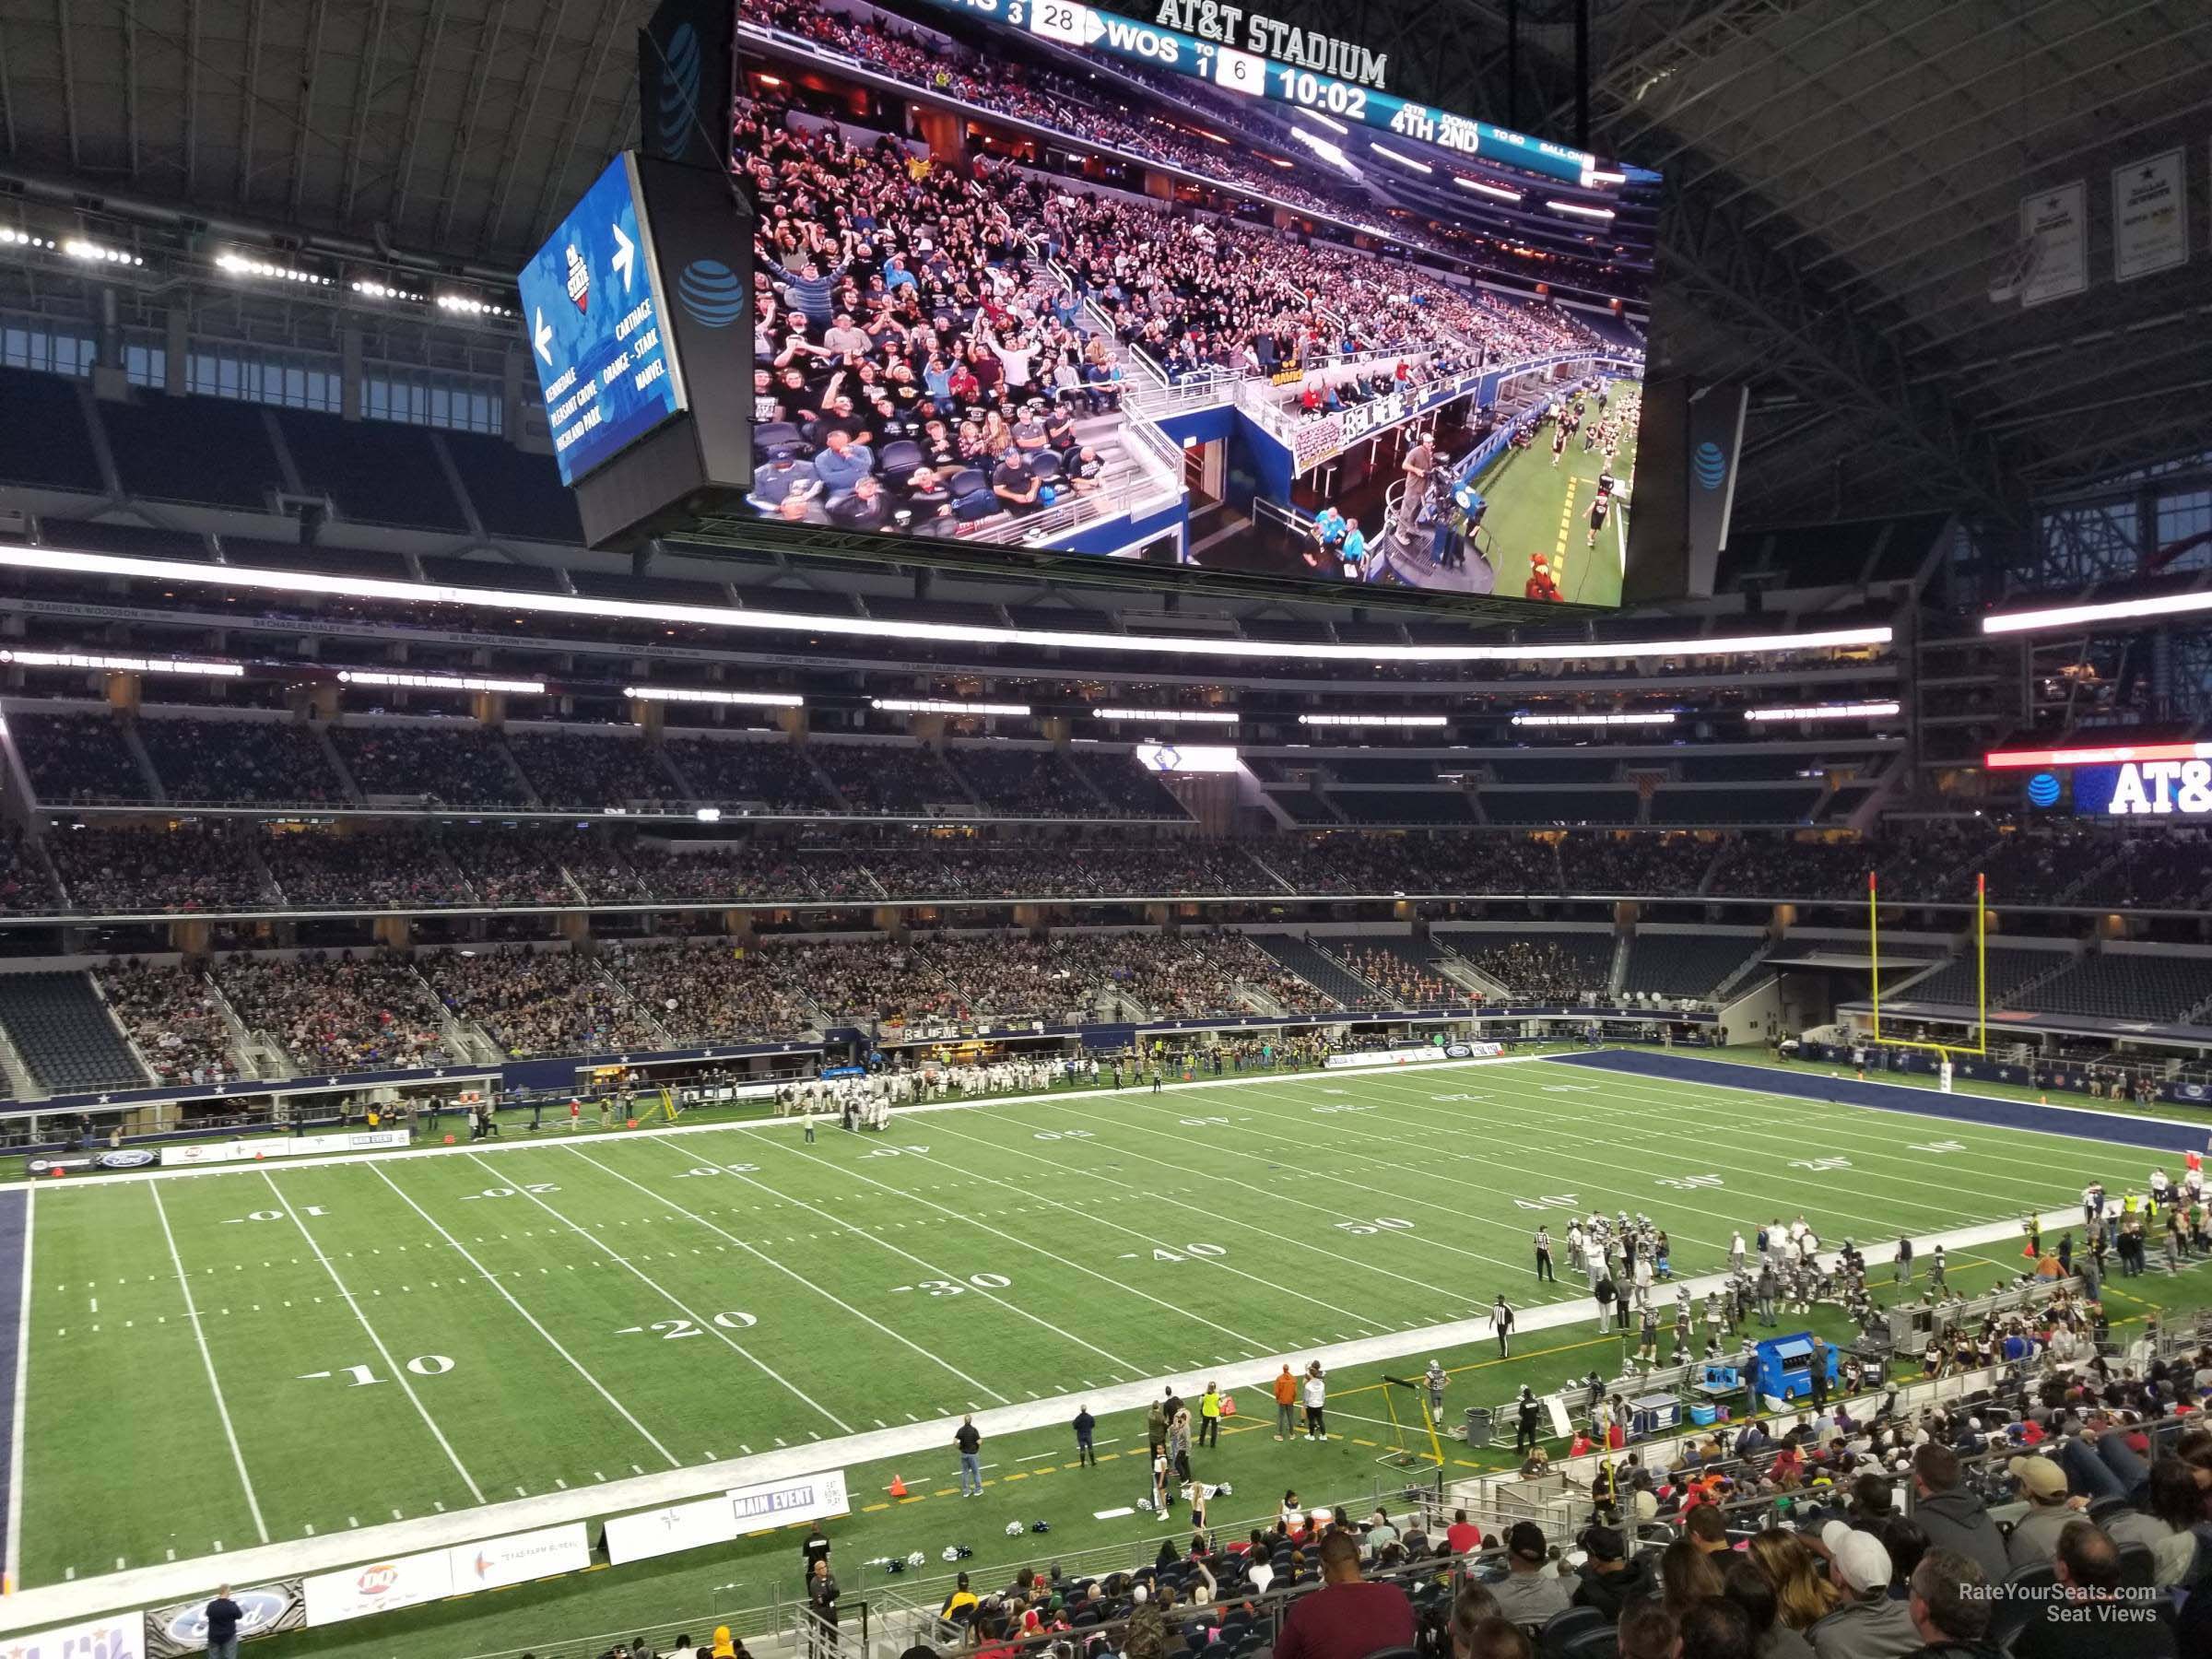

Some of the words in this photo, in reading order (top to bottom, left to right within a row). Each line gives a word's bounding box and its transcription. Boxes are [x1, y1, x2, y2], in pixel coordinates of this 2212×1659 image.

[1007, 3, 1023, 24] 3
[1043, 5, 1073, 30] 28
[1108, 20, 1179, 63] WOS
[1156, 0, 1242, 44] AT&T
[1248, 14, 1388, 89] STADIUM
[1194, 41, 1215, 57] TO
[1196, 57, 1208, 76] 1
[1234, 61, 1246, 79] 6
[1280, 68, 1367, 119] 10:02
[1390, 111, 1434, 141] 4TH
[1442, 114, 1477, 132] DOWN
[1437, 124, 1478, 153] 2ND
[1493, 129, 1509, 139] TO
[1509, 134, 1524, 145] GO
[1539, 143, 1566, 158] BALL
[1568, 150, 1583, 161] ON
[616, 298, 653, 341] CARTHAGE
[603, 352, 630, 384] ORANGE
[634, 328, 659, 359] STARK
[1334, 1217, 1416, 1235] 50
[1152, 1242, 1229, 1264] 40
[918, 1273, 1011, 1297] 30
[651, 1311, 758, 1339] 20
[339, 1355, 455, 1387] 10
[735, 1495, 769, 1517] MAIN
[772, 1488, 812, 1510] EVENT
[363, 1569, 394, 1586] DQ
